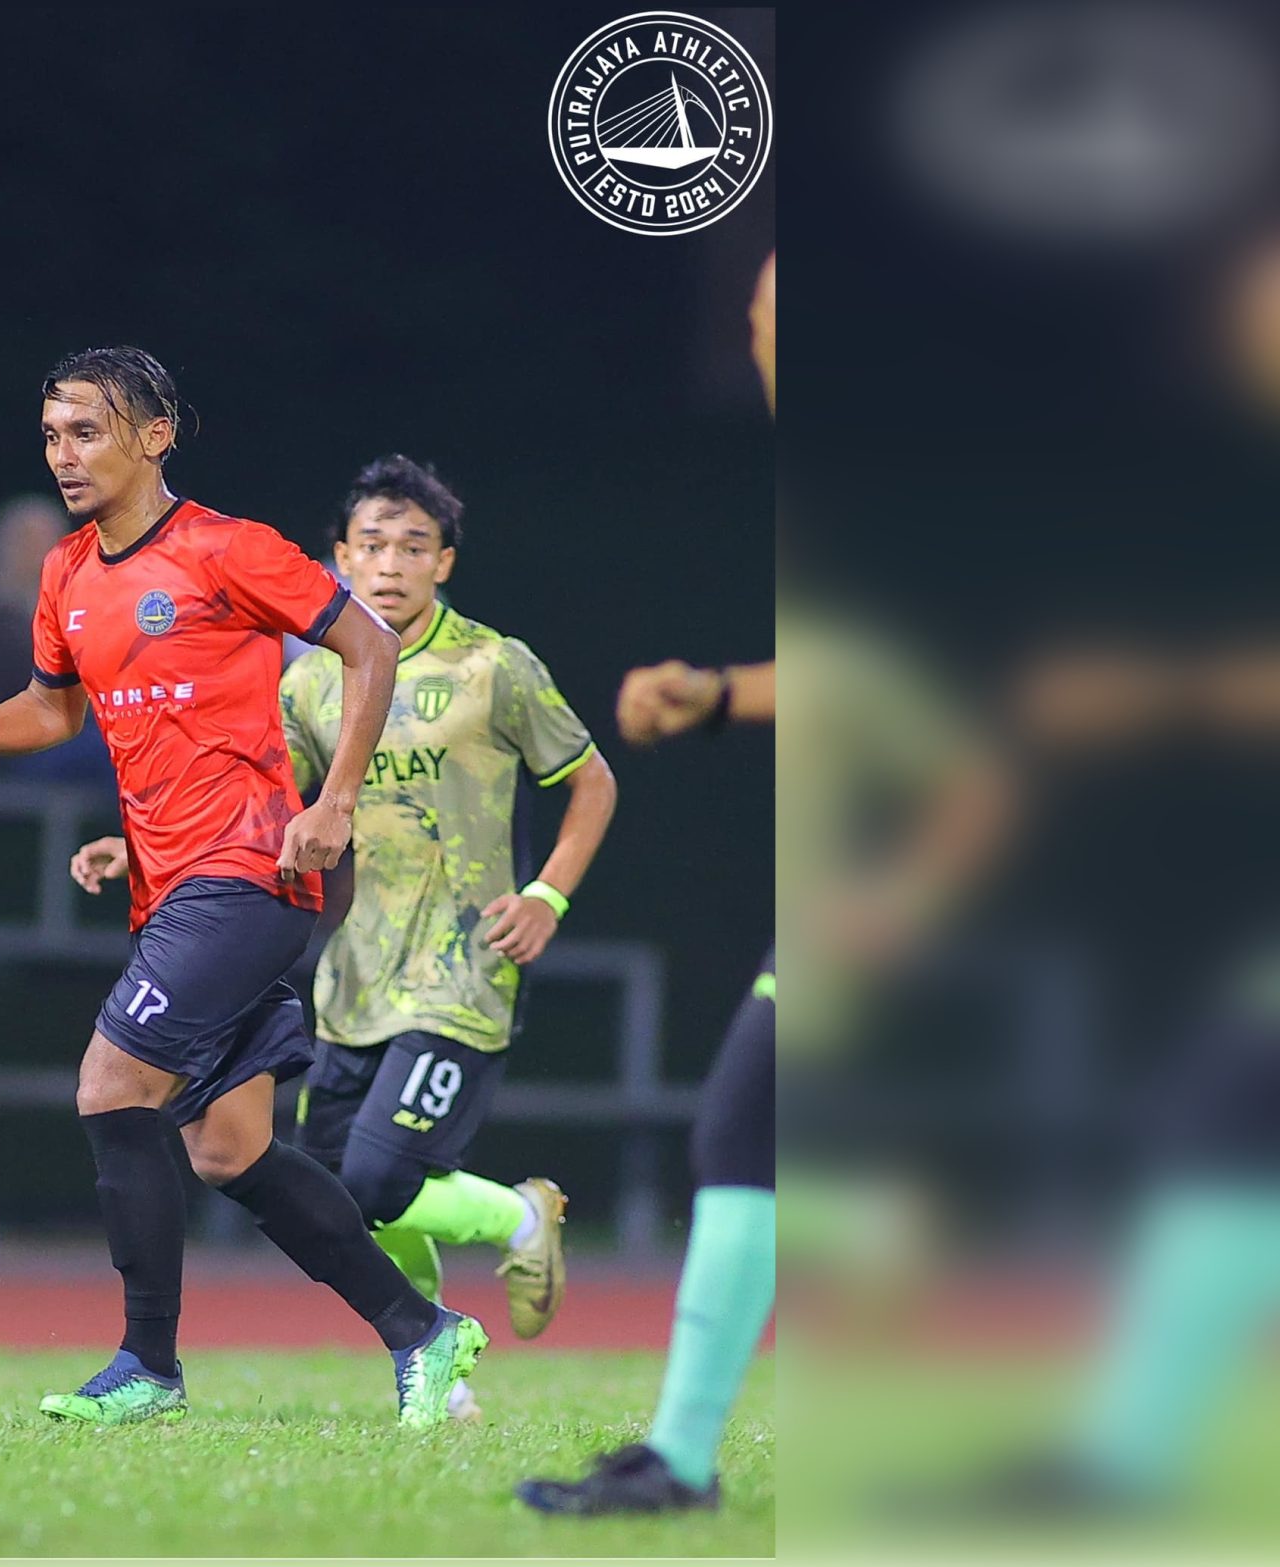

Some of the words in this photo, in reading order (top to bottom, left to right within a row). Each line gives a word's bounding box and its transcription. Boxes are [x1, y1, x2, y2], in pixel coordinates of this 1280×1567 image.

[364, 747, 448, 785] PLAY
[125, 980, 169, 1025] 17
[399, 1050, 463, 1119] 19
